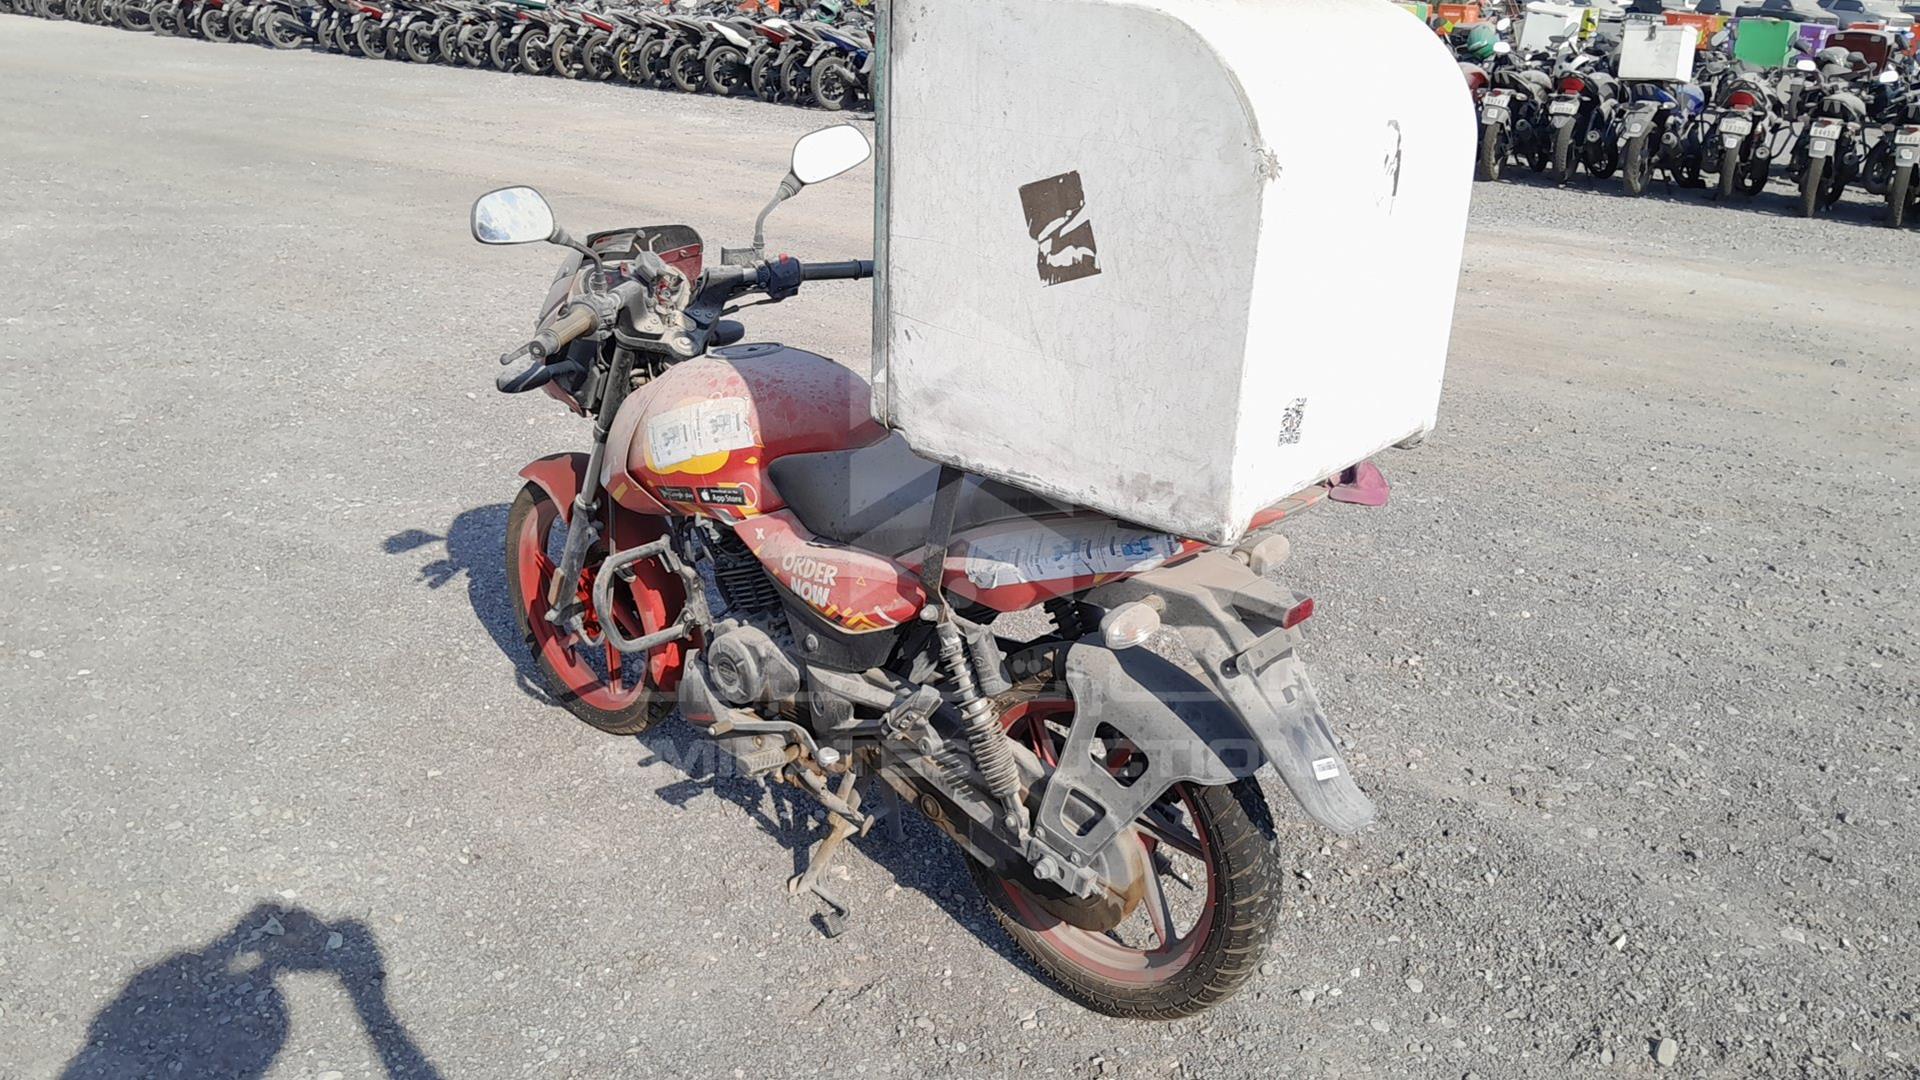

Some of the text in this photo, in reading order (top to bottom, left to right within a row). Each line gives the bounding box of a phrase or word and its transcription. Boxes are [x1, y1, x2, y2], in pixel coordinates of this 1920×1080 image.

[712, 494, 742, 503] App Store
[781, 552, 838, 586] ORDER
[790, 576, 830, 608] NOW
